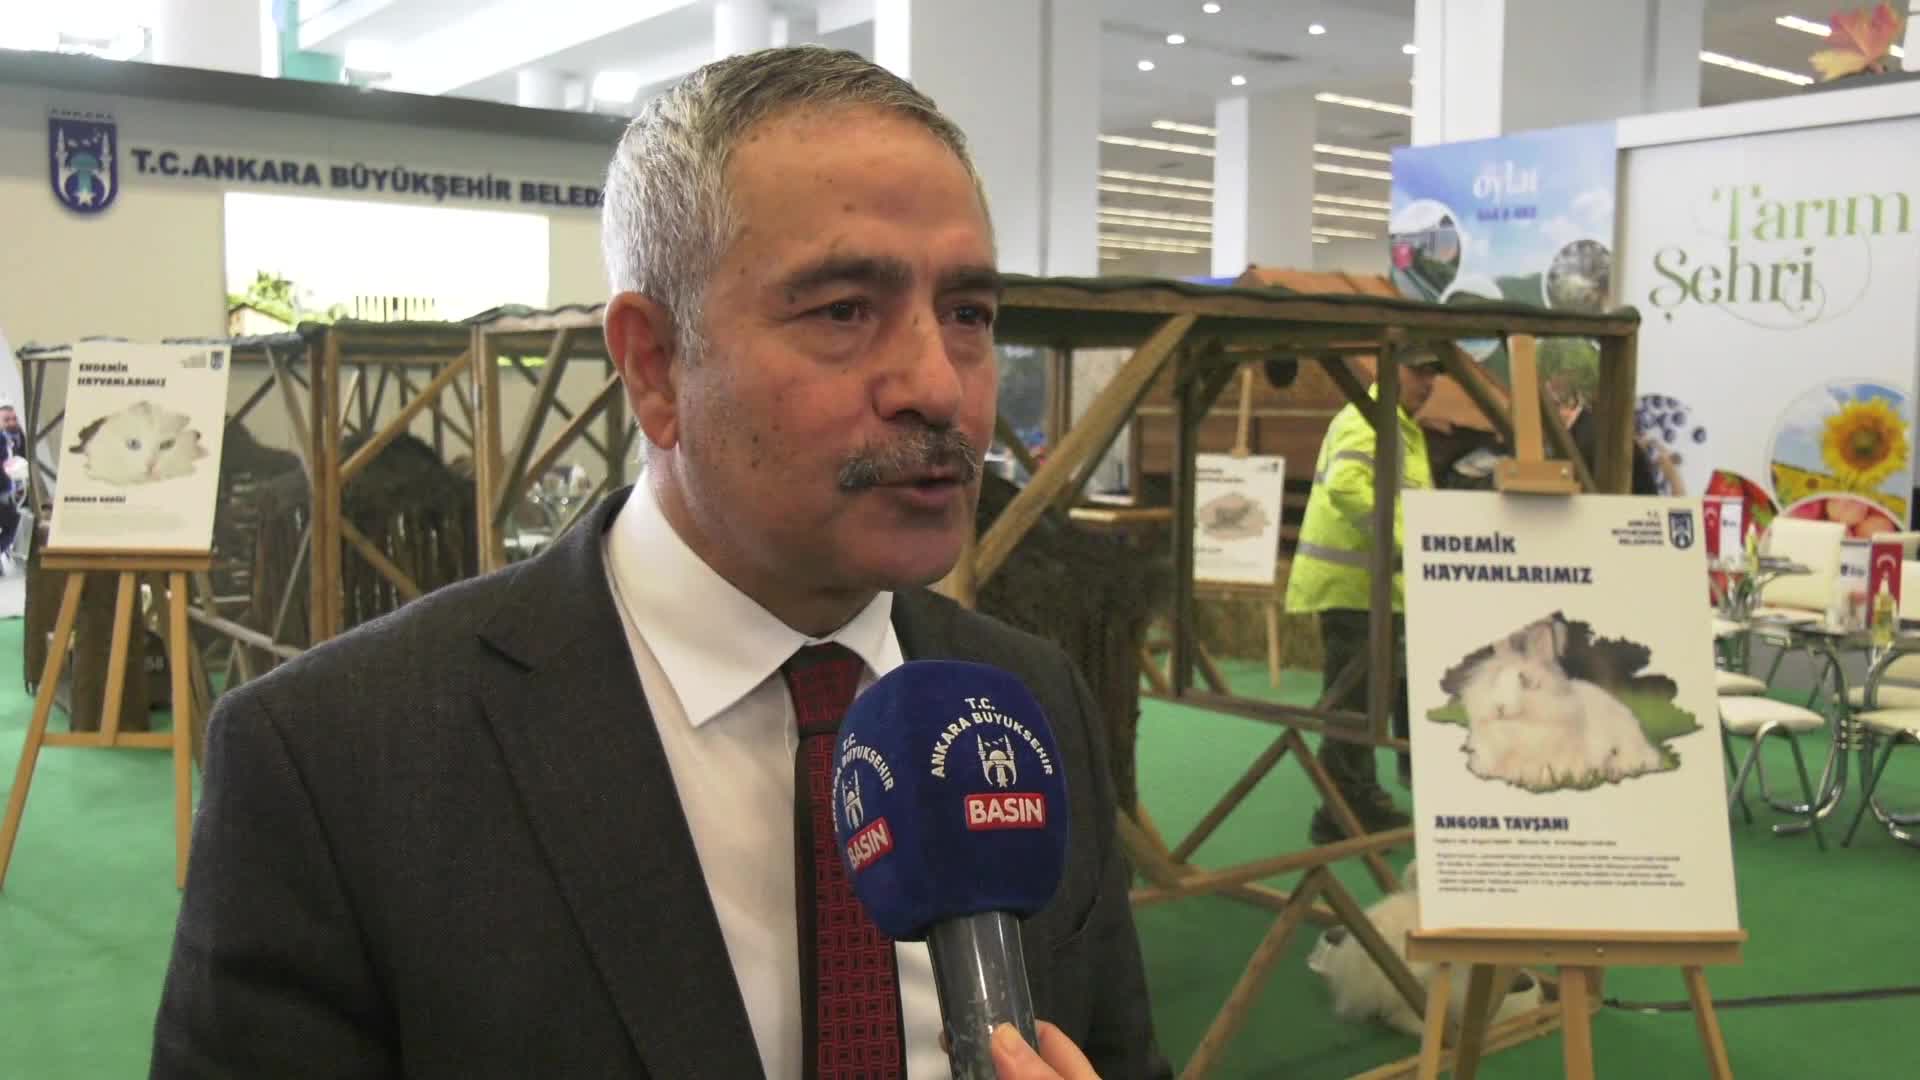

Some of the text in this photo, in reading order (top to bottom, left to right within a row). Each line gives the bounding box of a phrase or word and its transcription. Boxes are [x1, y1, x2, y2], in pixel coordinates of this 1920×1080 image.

[330, 163, 512, 201] BÜYÜKŞEHİR
[1711, 183, 1910, 241] Tarım
[1648, 246, 1816, 323] Şehri
[1421, 530, 1516, 554] ENDEMİK
[1422, 563, 1593, 584] HAYVANLARIMIZ
[964, 697, 996, 711] T.C.
[931, 716, 972, 779] ANKARA
[968, 798, 1044, 825] BASIN
[1435, 815, 1569, 832] ANGORA TAVŞANI
[847, 823, 890, 872] BASIN
